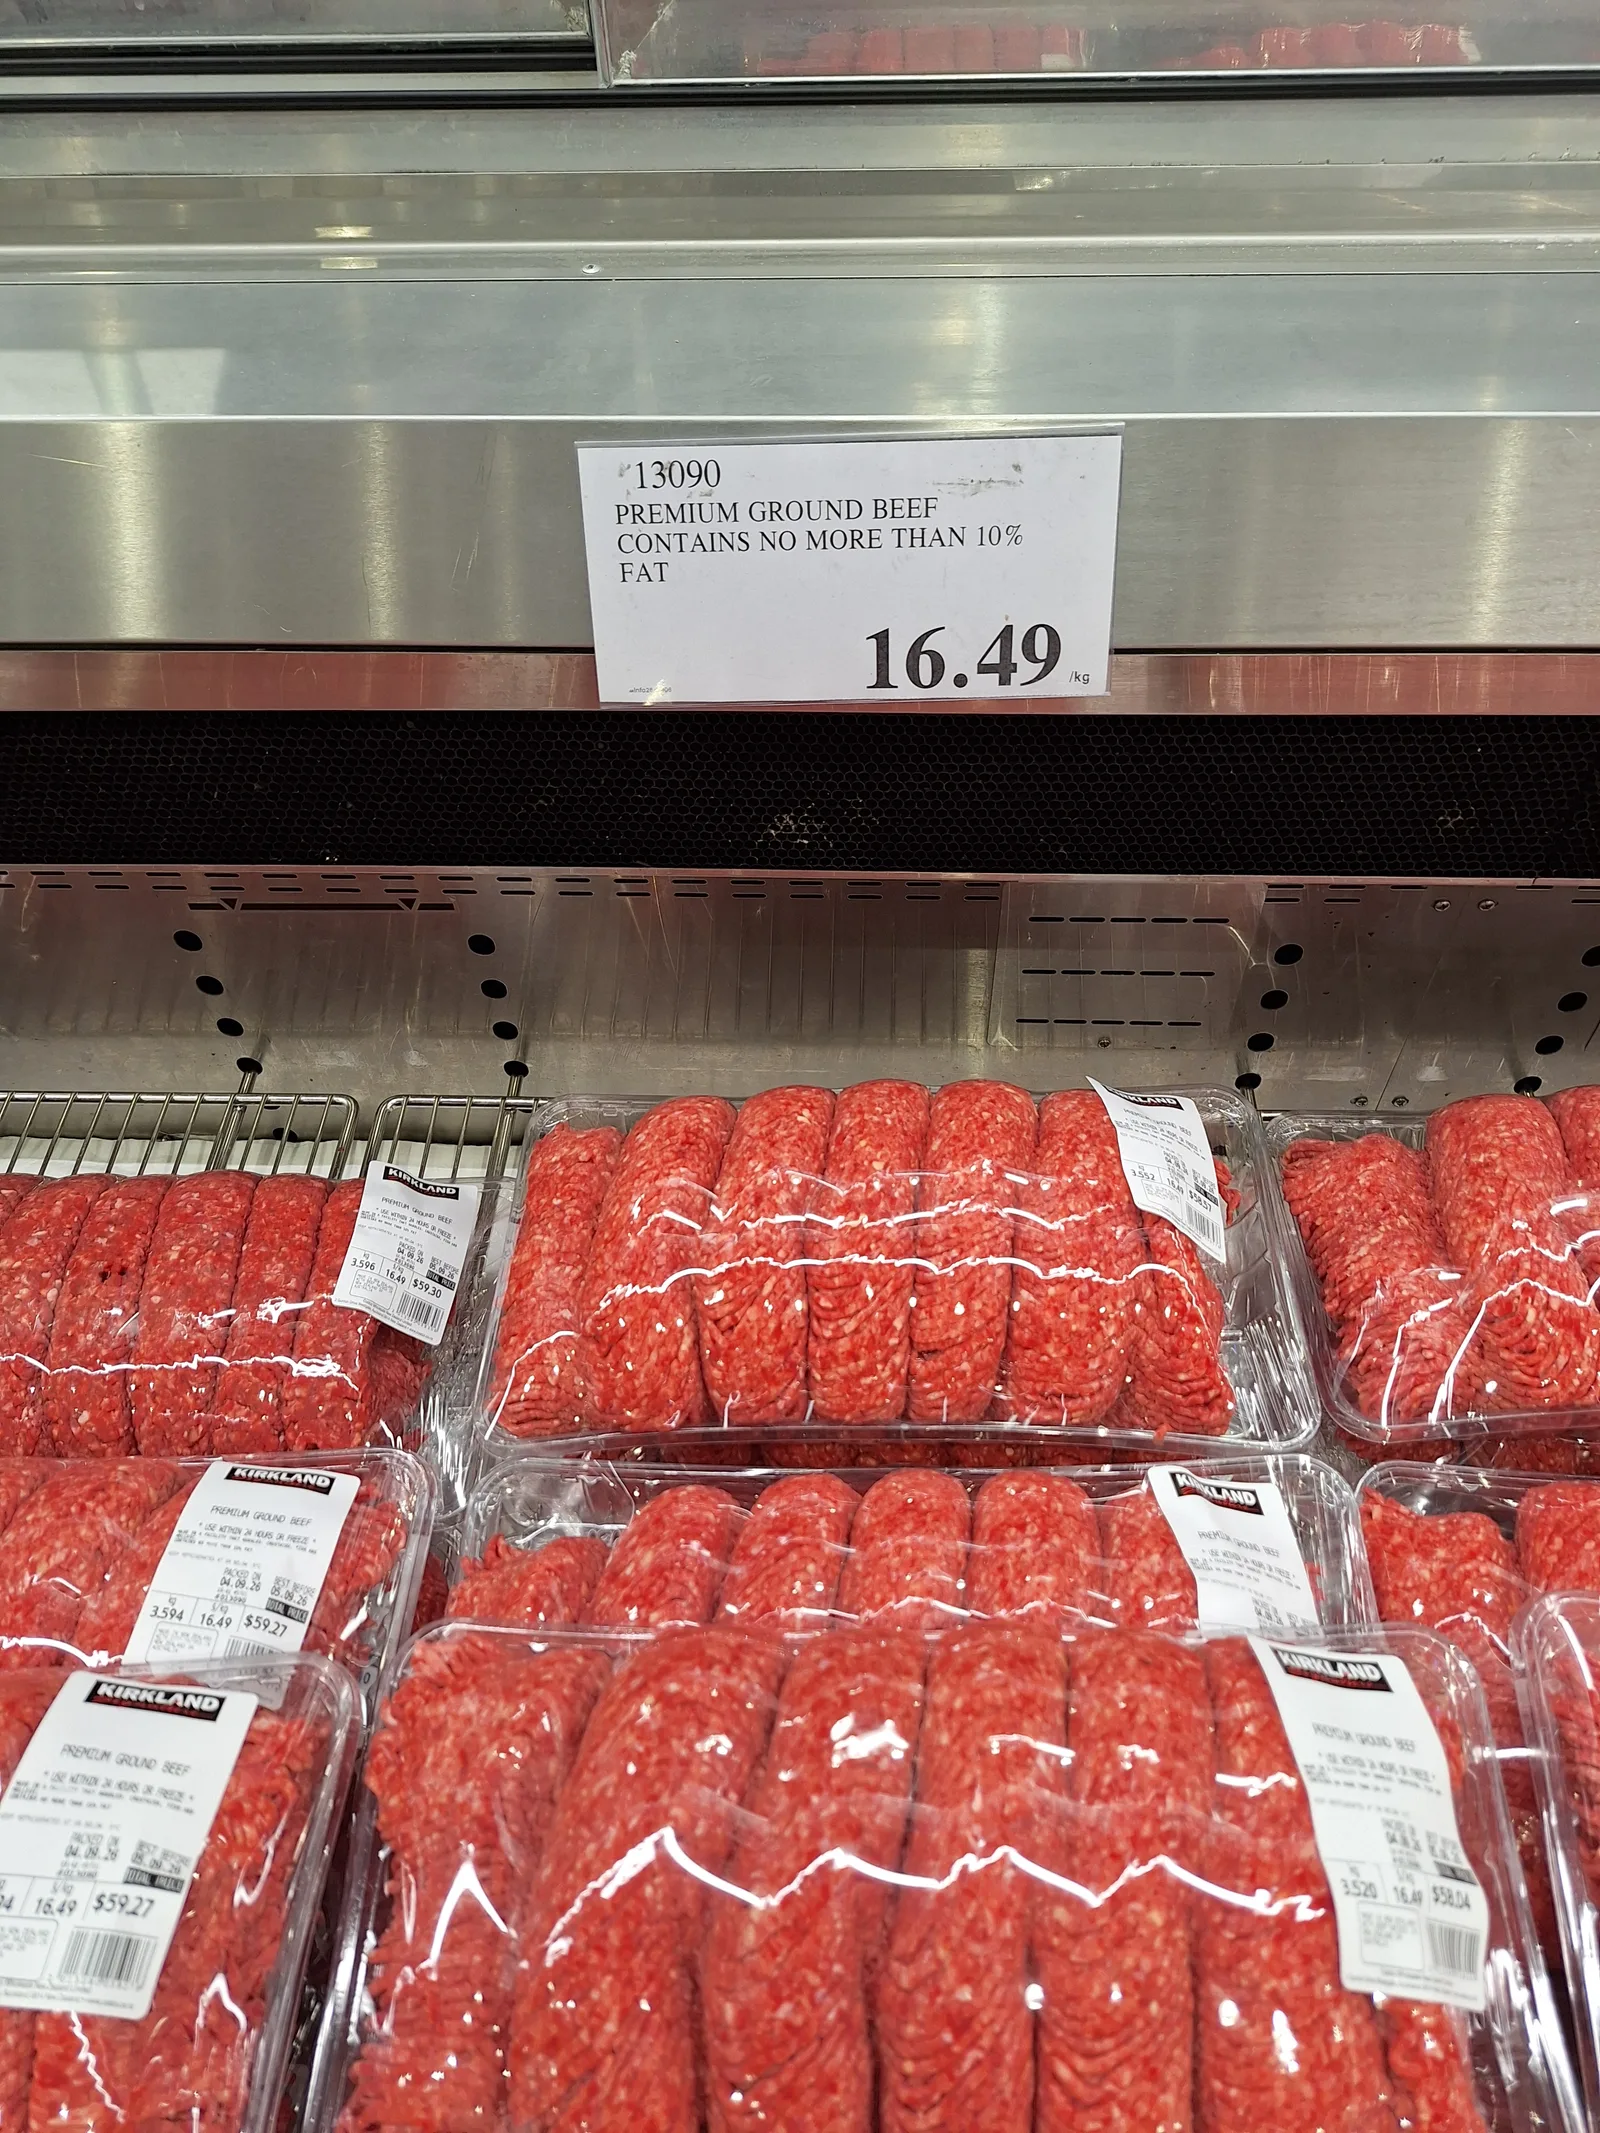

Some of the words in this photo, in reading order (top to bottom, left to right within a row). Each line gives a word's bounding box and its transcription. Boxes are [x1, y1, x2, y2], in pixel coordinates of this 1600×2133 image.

[635, 459, 721, 489] 13090
[615, 502, 740, 524] PREMIUM
[748, 499, 863, 522] GROUND
[872, 498, 938, 520] BEEF
[617, 531, 750, 554] CONTAINS
[759, 530, 796, 551] NO
[805, 528, 884, 550] MORE
[891, 526, 967, 548] THAN
[977, 524, 1023, 547] 10%
[619, 562, 669, 583] FAT
[866, 623, 1061, 689] 16.49
[1068, 671, 1090, 685] /kg
[388, 1168, 456, 1195] KIRKLAND
[1130, 1168, 1155, 1181] 3.552
[381, 1197, 410, 1210] PREMIUM
[412, 1207, 434, 1219] GROUND
[437, 1214, 453, 1225] BEEF
[396, 1247, 424, 1264] 04.09.26
[350, 1258, 376, 1271] 3.596
[385, 1269, 406, 1285] 16.49
[412, 1278, 442, 1299] $59.30
[429, 1262, 455, 1280] 05.09.26
[233, 1468, 331, 1488] KIRKLAND
[210, 1505, 250, 1518] PREMIUM
[253, 1511, 286, 1523] GROUND
[290, 1516, 312, 1526] BEEF
[219, 1576, 261, 1592] 04.09.26
[270, 1585, 308, 1606] 05.09.26
[150, 1605, 185, 1622] 3.594
[200, 1613, 232, 1629] 16.49
[243, 1613, 288, 1638] $59.27
[1276, 1649, 1382, 1682] KIRKLAND
[96, 1682, 221, 1712] KIRKLAND
[61, 1743, 110, 1763] PREMIUM
[115, 1752, 157, 1770] GROUND
[161, 1759, 191, 1776] BEEF
[1340, 1877, 1377, 1899] 3.520
[35, 1897, 77, 1916] 16.49
[93, 1892, 154, 1917] $59.27
